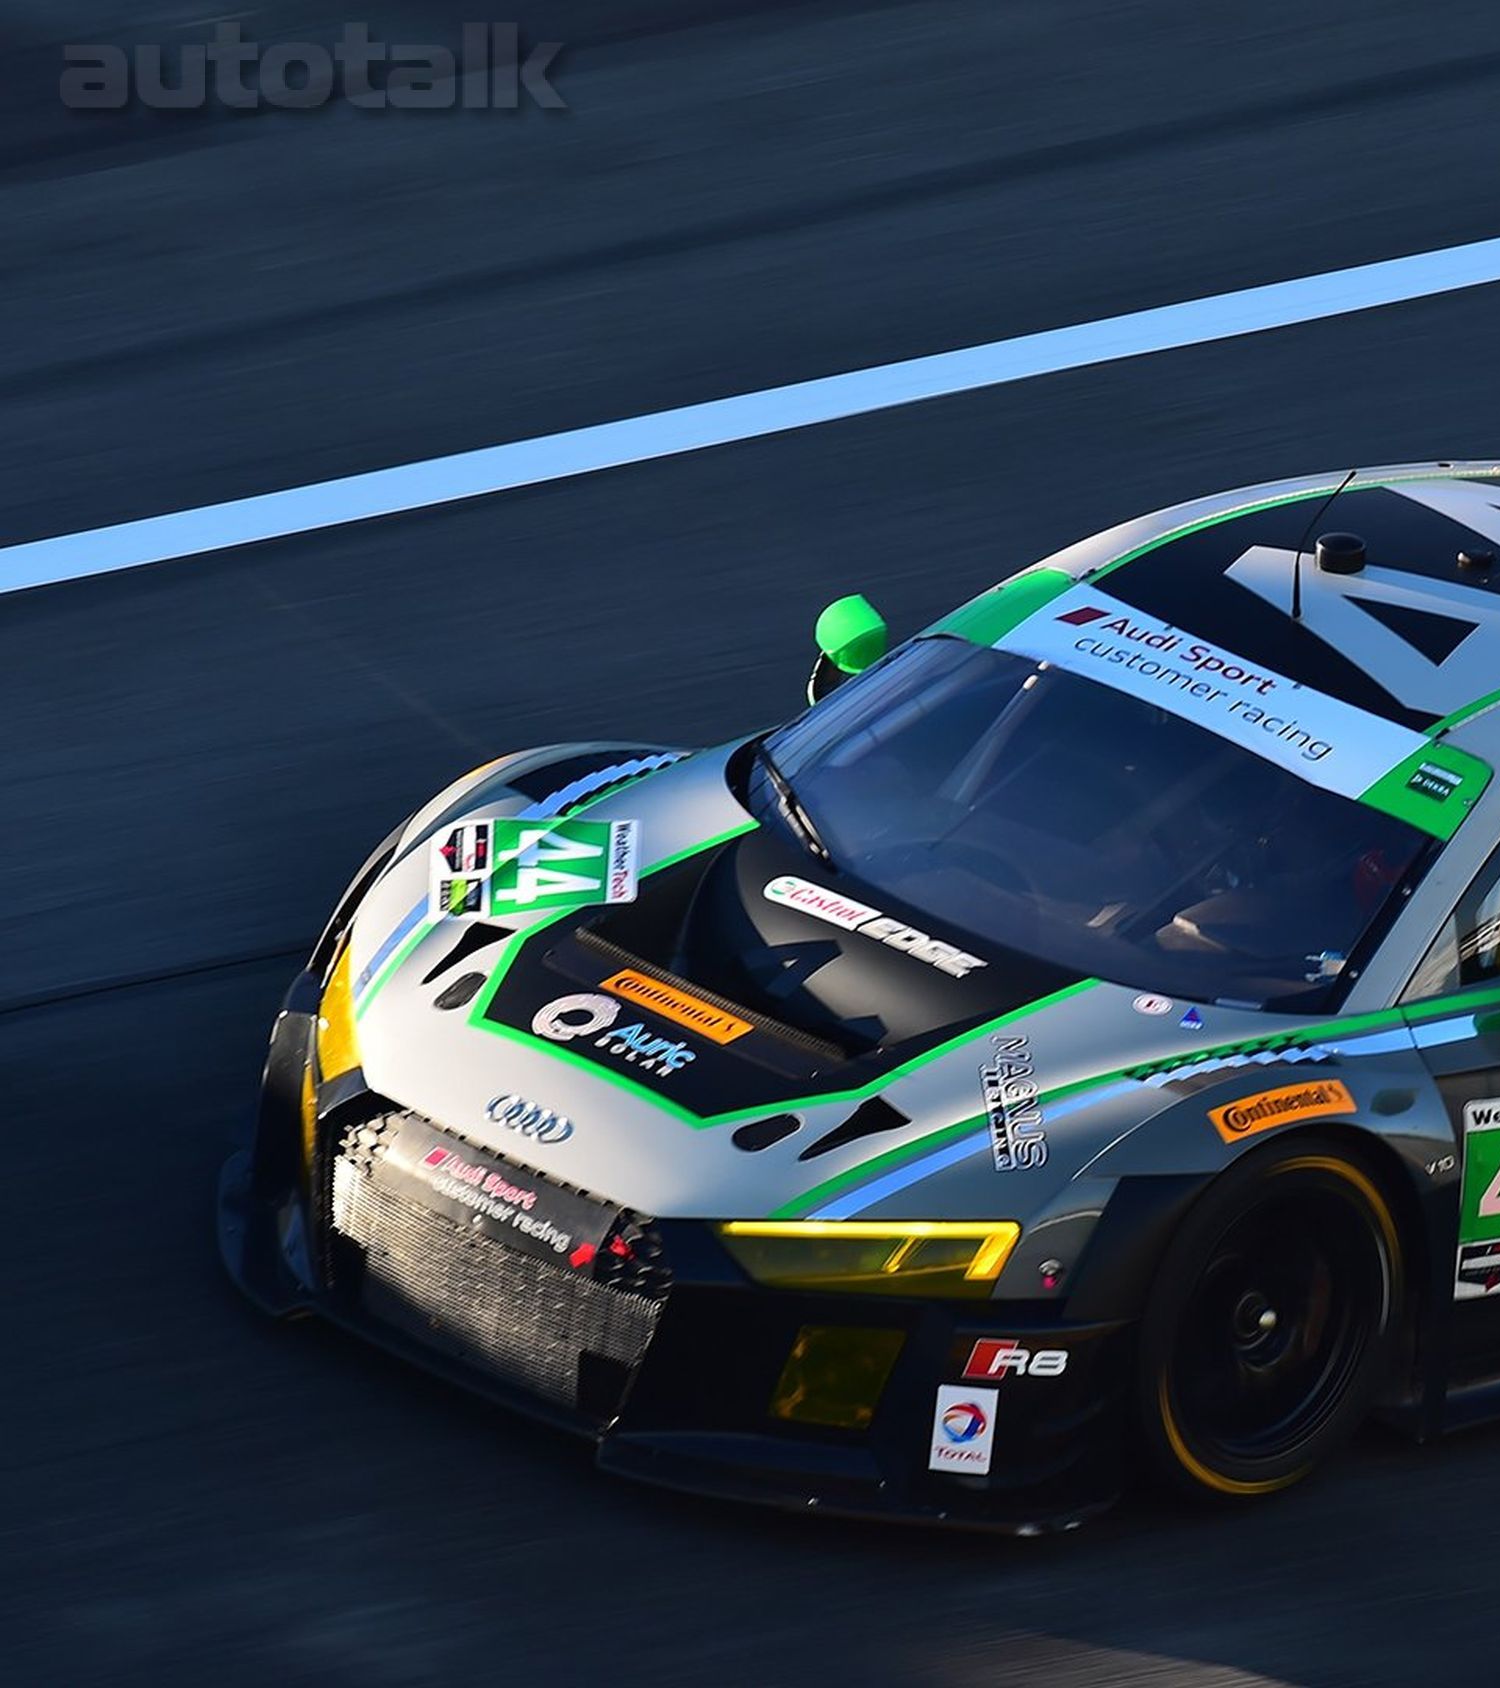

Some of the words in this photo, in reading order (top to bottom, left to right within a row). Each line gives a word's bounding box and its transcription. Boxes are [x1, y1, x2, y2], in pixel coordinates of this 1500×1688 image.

[1100, 617, 1182, 654] Audi
[1179, 644, 1278, 697] Sport
[1074, 635, 1229, 704] customer
[1228, 697, 1333, 762] racing
[496, 829, 604, 905] 44
[789, 888, 868, 922] Castrol
[856, 916, 990, 979] EDGE
[614, 976, 725, 1029] Continental
[594, 1035, 675, 1078] SOLAR
[606, 1022, 697, 1069] Auric
[990, 1034, 1050, 1170] MAGNUS
[1222, 1084, 1332, 1133] Continental
[441, 1154, 488, 1186] Audi
[481, 1172, 538, 1211] Sport
[1425, 1155, 1455, 1175] V10
[431, 1174, 516, 1222] customer
[512, 1211, 573, 1254] racing
[987, 1348, 1069, 1376] R8
[935, 1445, 988, 1464] TOTAL
